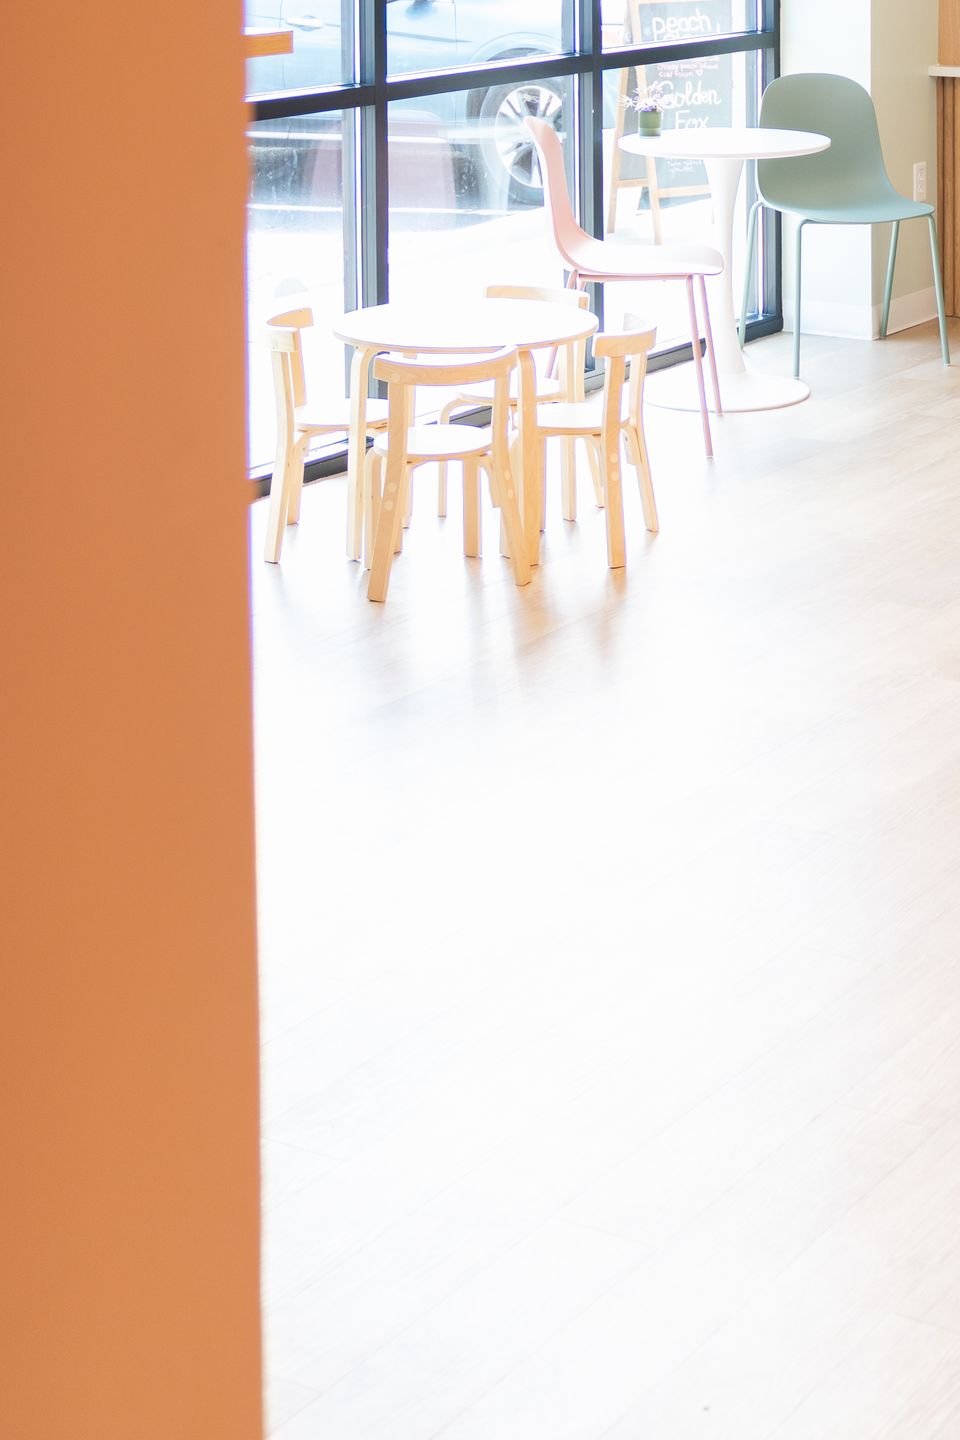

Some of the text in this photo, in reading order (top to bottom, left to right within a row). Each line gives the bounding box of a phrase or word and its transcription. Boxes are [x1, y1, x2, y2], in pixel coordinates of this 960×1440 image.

[652, 8, 712, 40] peach
[659, 80, 722, 109] Golden
[675, 109, 710, 128] Fox
